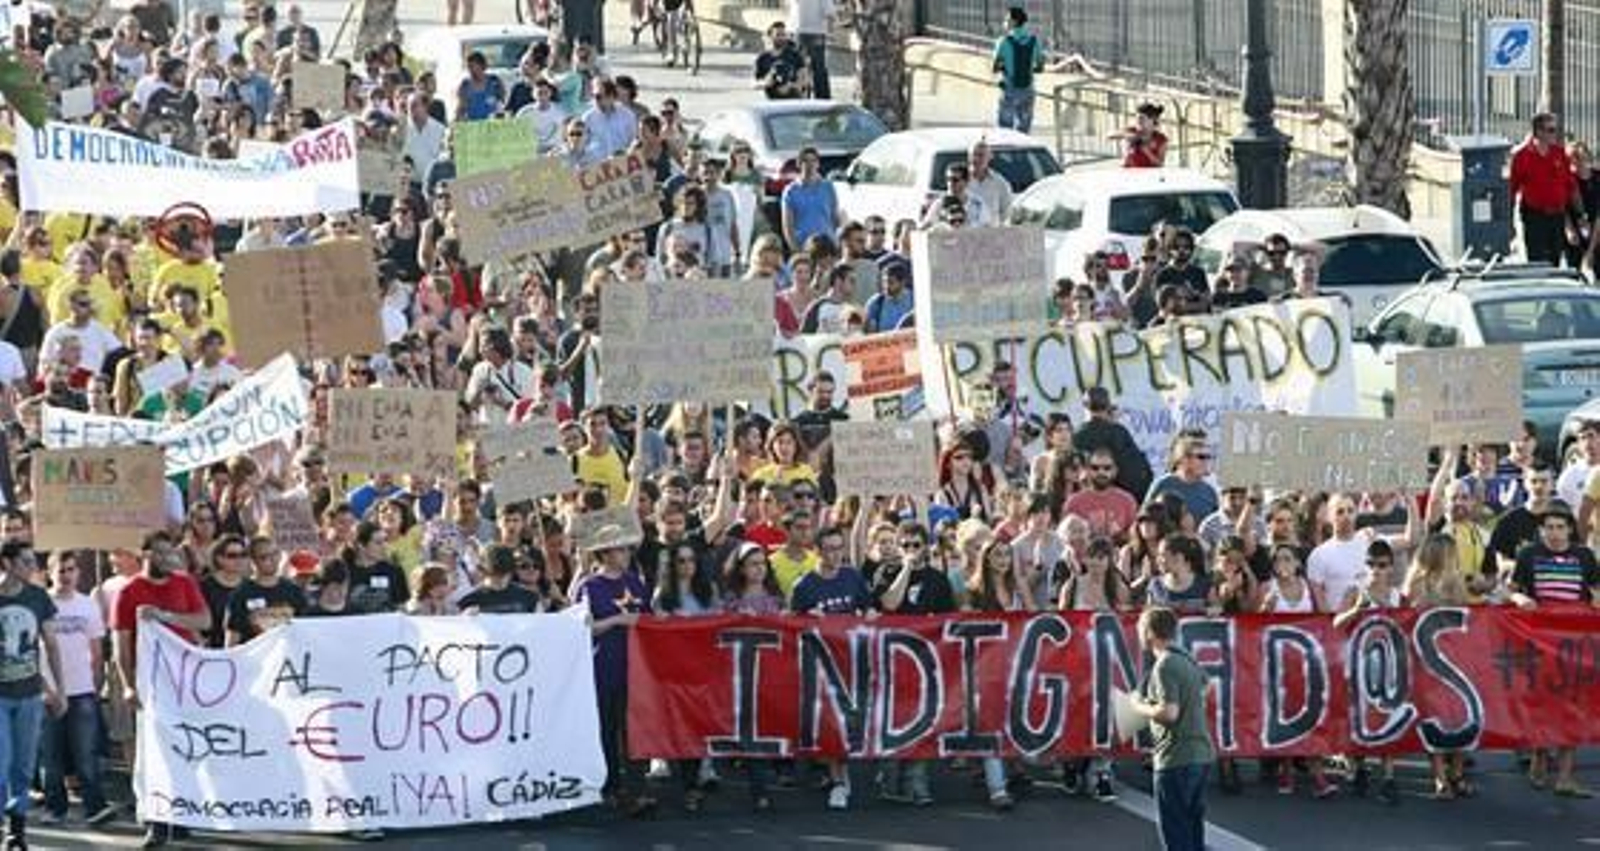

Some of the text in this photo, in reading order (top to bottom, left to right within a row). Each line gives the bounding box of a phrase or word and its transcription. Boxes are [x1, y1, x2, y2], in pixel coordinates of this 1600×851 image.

[151, 639, 530, 709] NO AL PACTO
[707, 606, 1485, 758] INDIGNAD@S
[171, 687, 536, 762] DEL €URO!!
